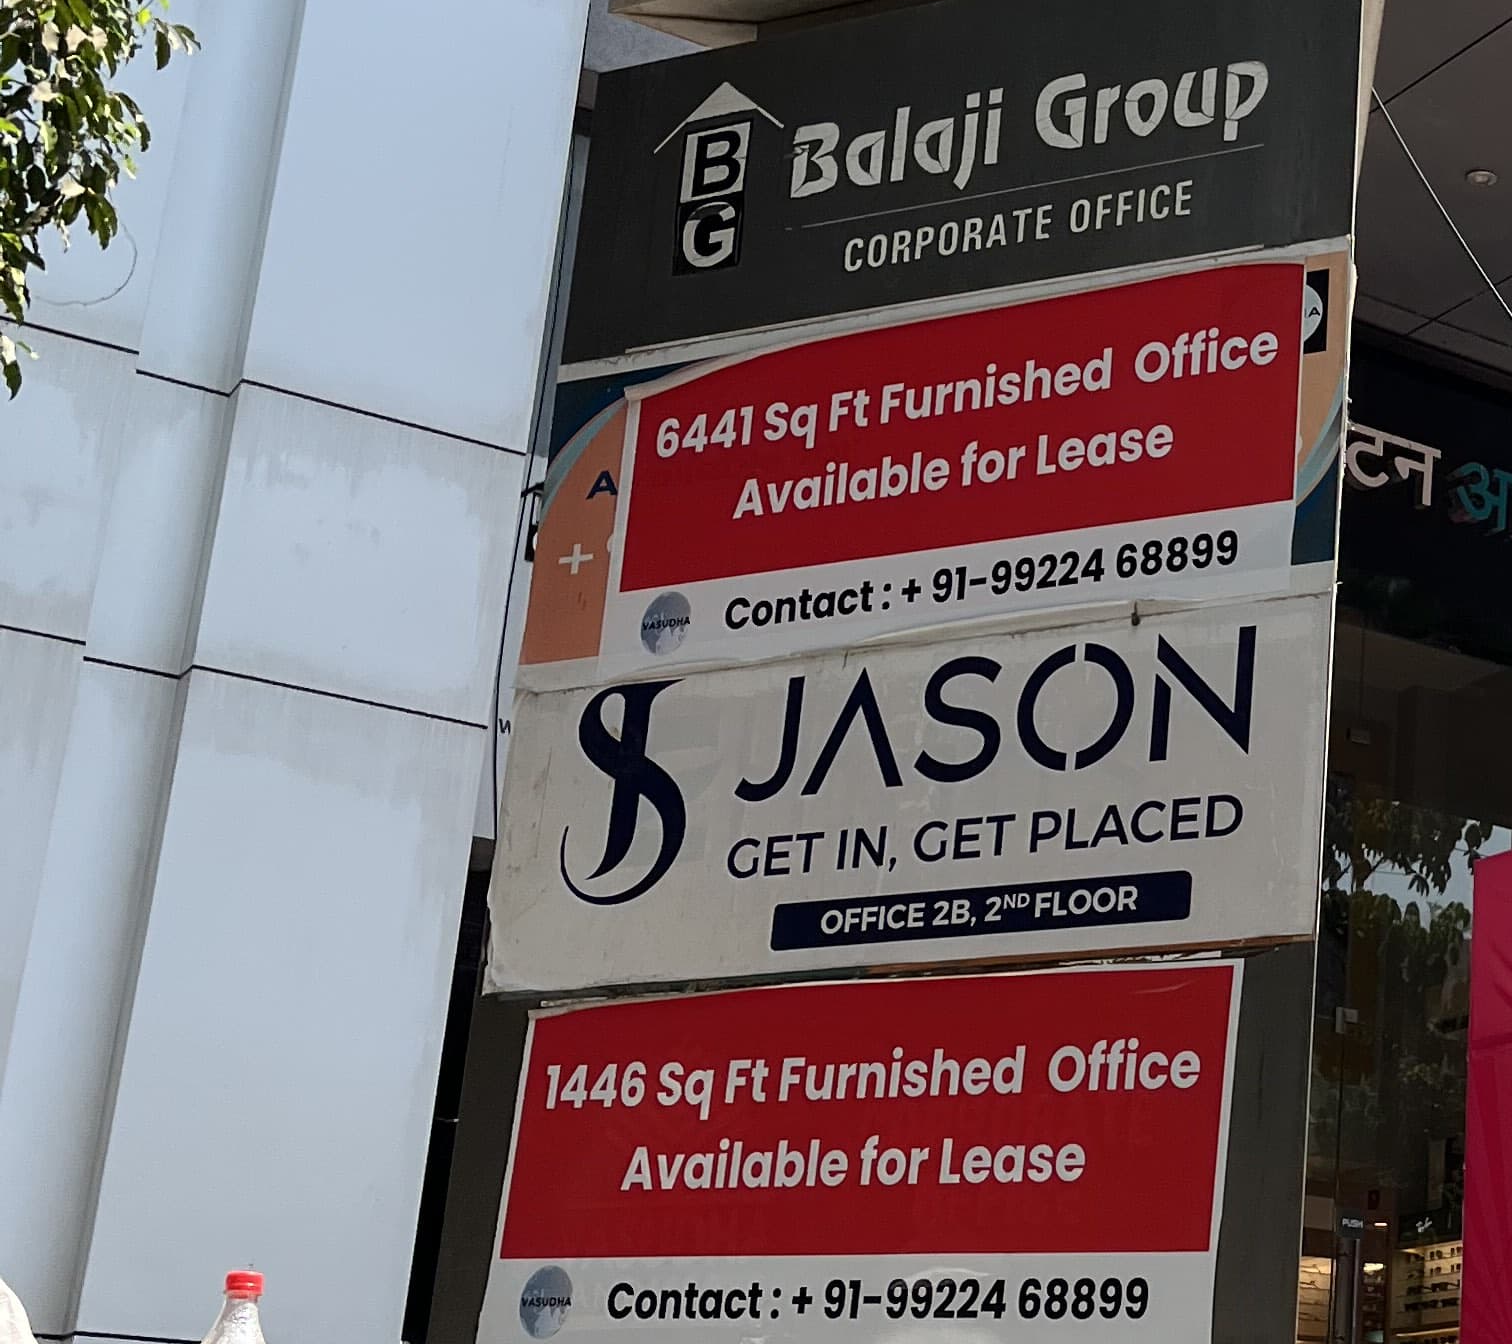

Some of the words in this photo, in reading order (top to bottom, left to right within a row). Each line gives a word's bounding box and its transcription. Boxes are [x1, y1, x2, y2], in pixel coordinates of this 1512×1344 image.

[790, 87, 1004, 198] Balaji
[1035, 60, 1269, 149] Group
[843, 204, 1053, 272] CORPORATE
[1069, 179, 1193, 233] OFFICE
[656, 405, 754, 458] 6441
[763, 402, 818, 449] Sq
[828, 389, 870, 432] Ft
[880, 347, 1112, 424] Furnished
[1134, 327, 1278, 383] Office
[732, 451, 950, 520] Available
[961, 441, 1026, 487] for
[1036, 424, 1174, 475] Lease
[1115, 530, 1239, 578] 68899
[642, 616, 691, 632] VASUDHA
[734, 625, 1257, 802] JASON
[727, 831, 825, 879] GET
[836, 826, 896, 872] IN,
[913, 813, 1016, 862] GET
[1029, 794, 1243, 853] PLACED
[820, 902, 925, 935] OFFICE
[932, 899, 977, 927] 2B,
[984, 892, 1030, 922] 2ND
[1034, 885, 1138, 918] FLOOR
[546, 1061, 647, 1109] 1446
[656, 1062, 714, 1120] Sq
[724, 1058, 769, 1104] Ft
[778, 1045, 1026, 1101] Furnished
[1048, 1037, 1200, 1092] Office
[620, 1138, 848, 1190] Available
[860, 1135, 929, 1186] for
[938, 1137, 1086, 1184] Lease
[521, 1296, 572, 1308] VASUDHA
[1018, 1277, 1149, 1320] 68899
